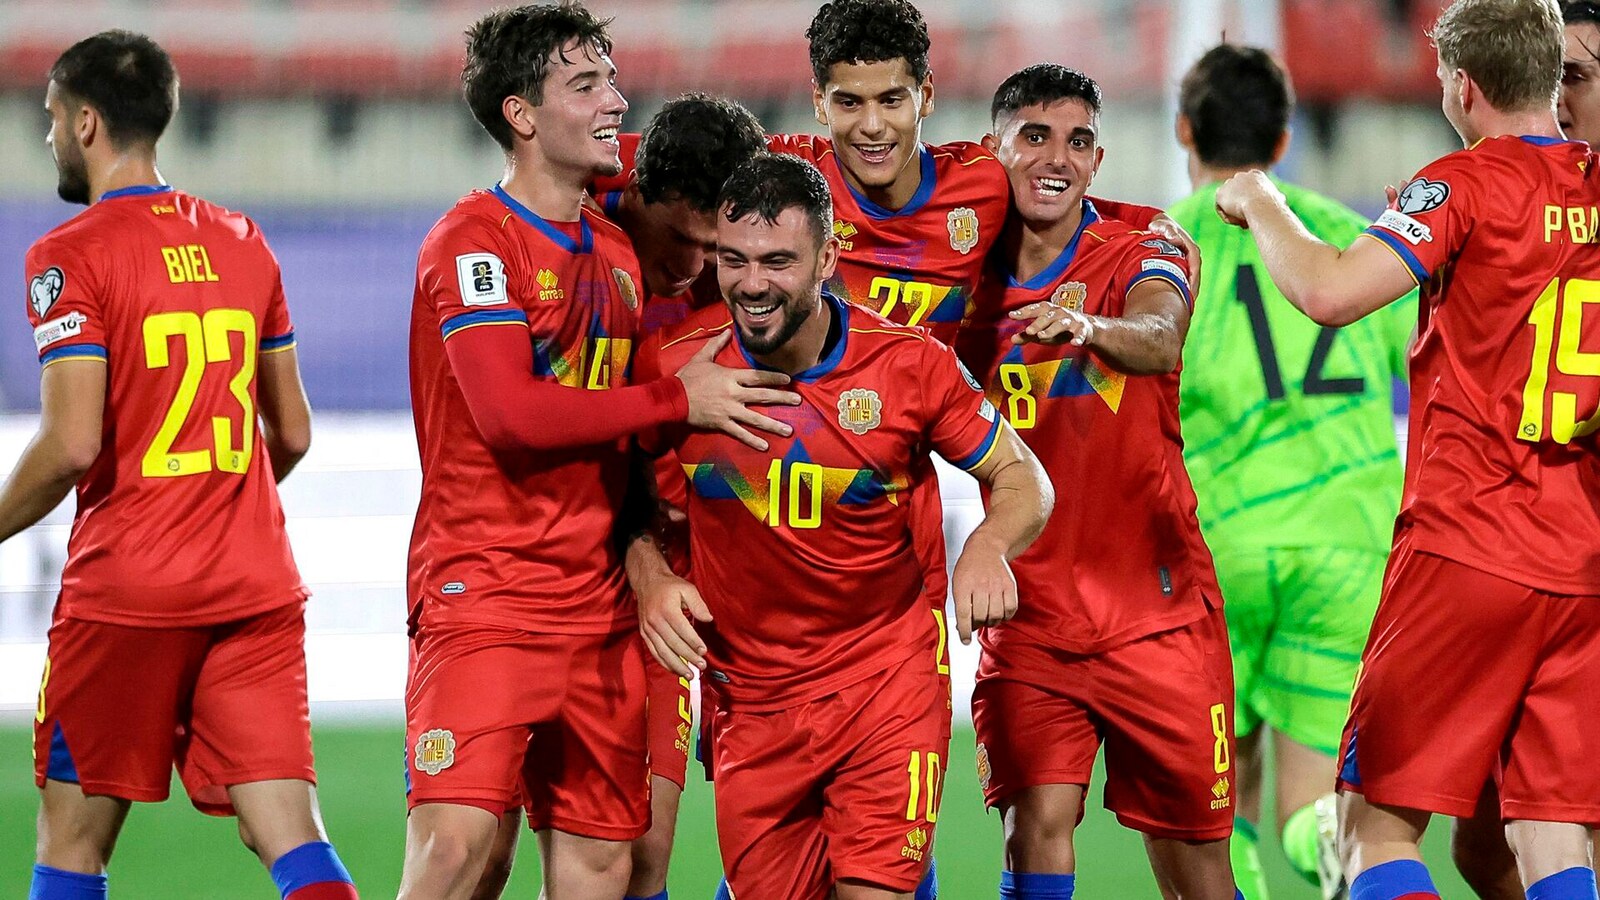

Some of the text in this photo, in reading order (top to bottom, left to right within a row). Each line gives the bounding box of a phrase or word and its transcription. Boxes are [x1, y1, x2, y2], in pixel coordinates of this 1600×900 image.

[1544, 205, 1562, 243] P
[161, 244, 220, 284] BIEL
[868, 276, 932, 327] 22
[141, 307, 257, 478] 23
[999, 363, 1037, 429] 8
[766, 458, 824, 529] 10
[1210, 703, 1230, 774] 8
[906, 750, 941, 823] 10
